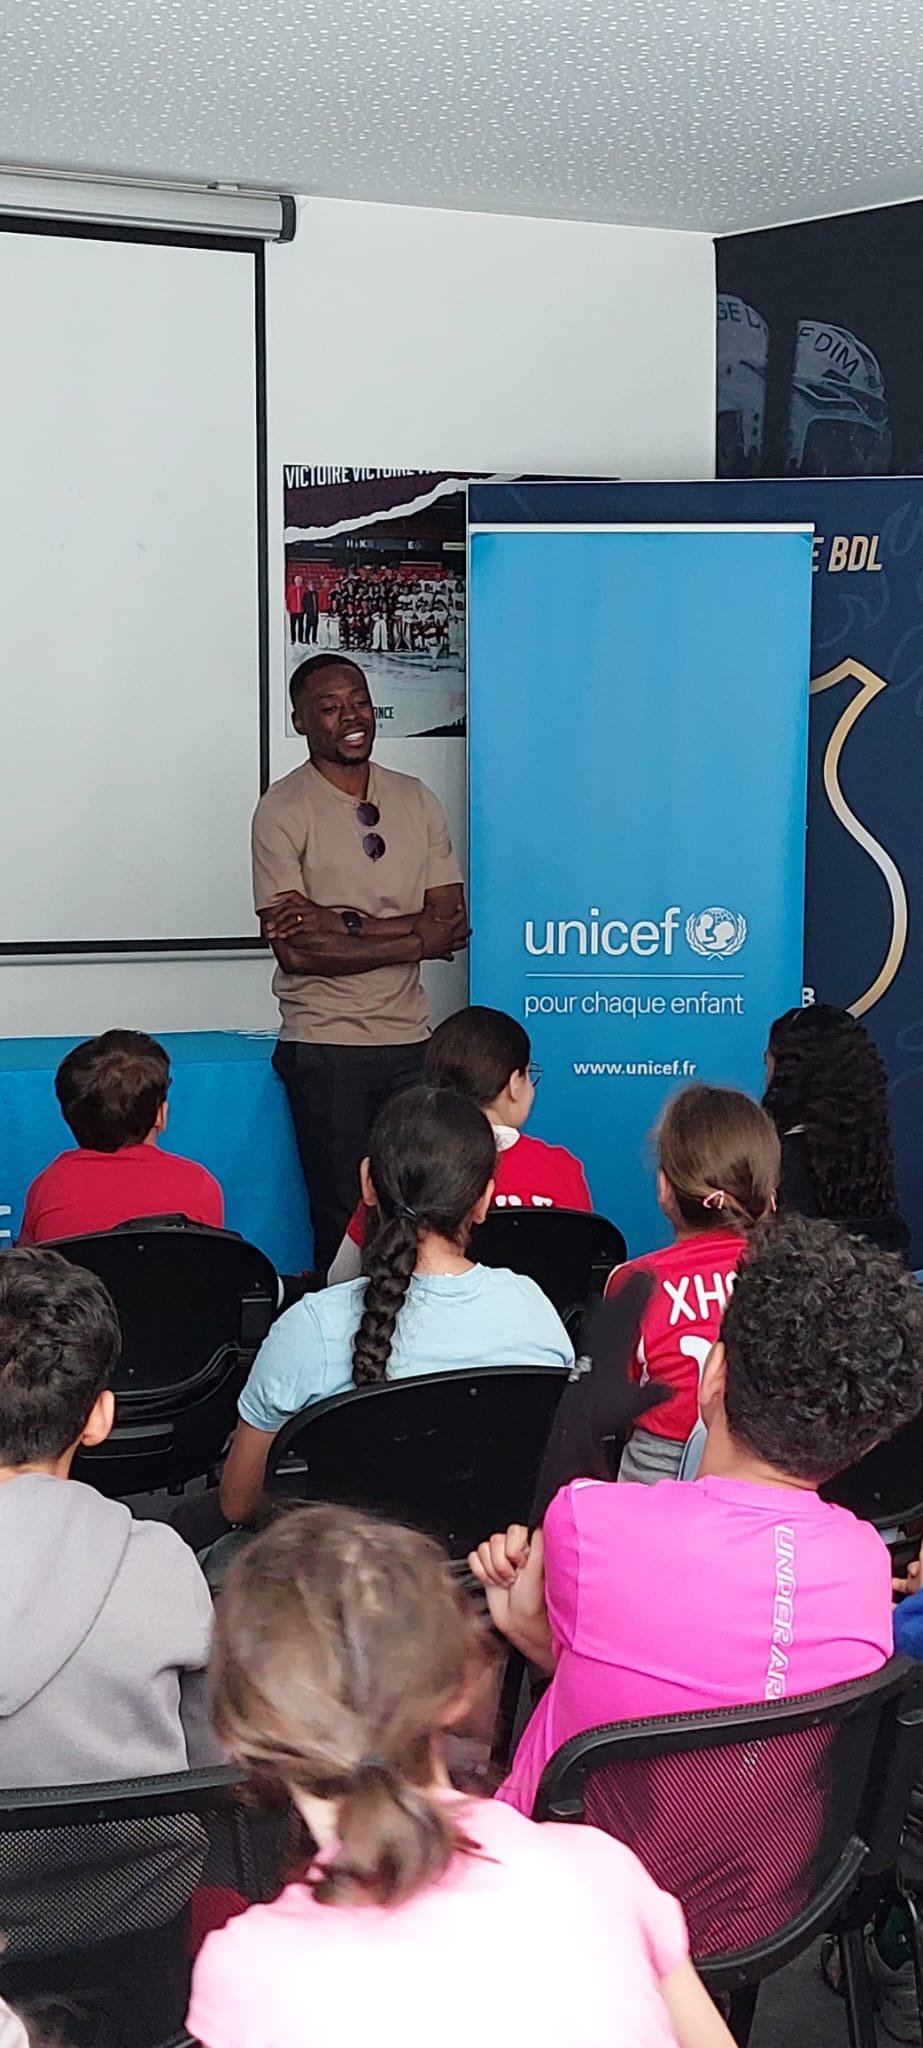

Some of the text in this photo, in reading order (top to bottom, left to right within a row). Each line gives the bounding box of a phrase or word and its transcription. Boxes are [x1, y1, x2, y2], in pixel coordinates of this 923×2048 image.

[813, 332, 860, 378] DIM
[285, 466, 350, 490] VICTOIRE
[827, 535, 883, 572] BDL
[524, 907, 682, 956] unicef
[524, 991, 745, 1018] pour chaque enfant
[572, 1060, 698, 1077] www.unicef.fr
